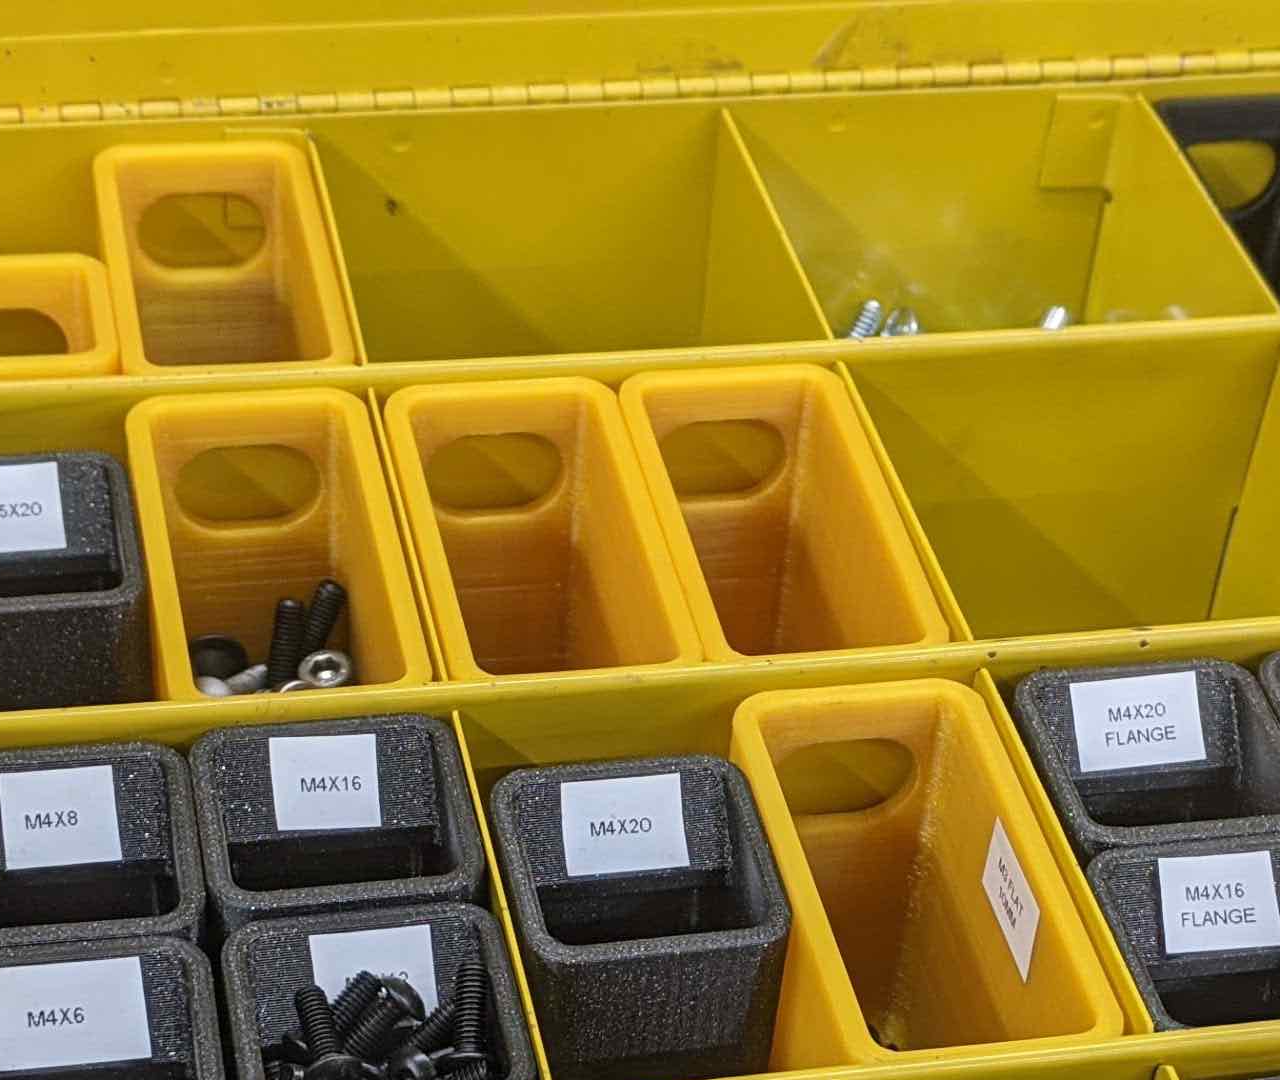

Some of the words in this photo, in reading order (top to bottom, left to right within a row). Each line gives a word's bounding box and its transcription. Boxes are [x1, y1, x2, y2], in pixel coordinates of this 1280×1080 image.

[1107, 702, 1167, 723] M4X20
[1104, 724, 1177, 747] FLANGE
[300, 775, 362, 793] M4X16
[24, 810, 79, 830] M4X8
[589, 817, 652, 837] M4X20
[1184, 882, 1245, 902] M4X16
[1180, 907, 1257, 928] FLANGE
[26, 1006, 85, 1028] M4X6
